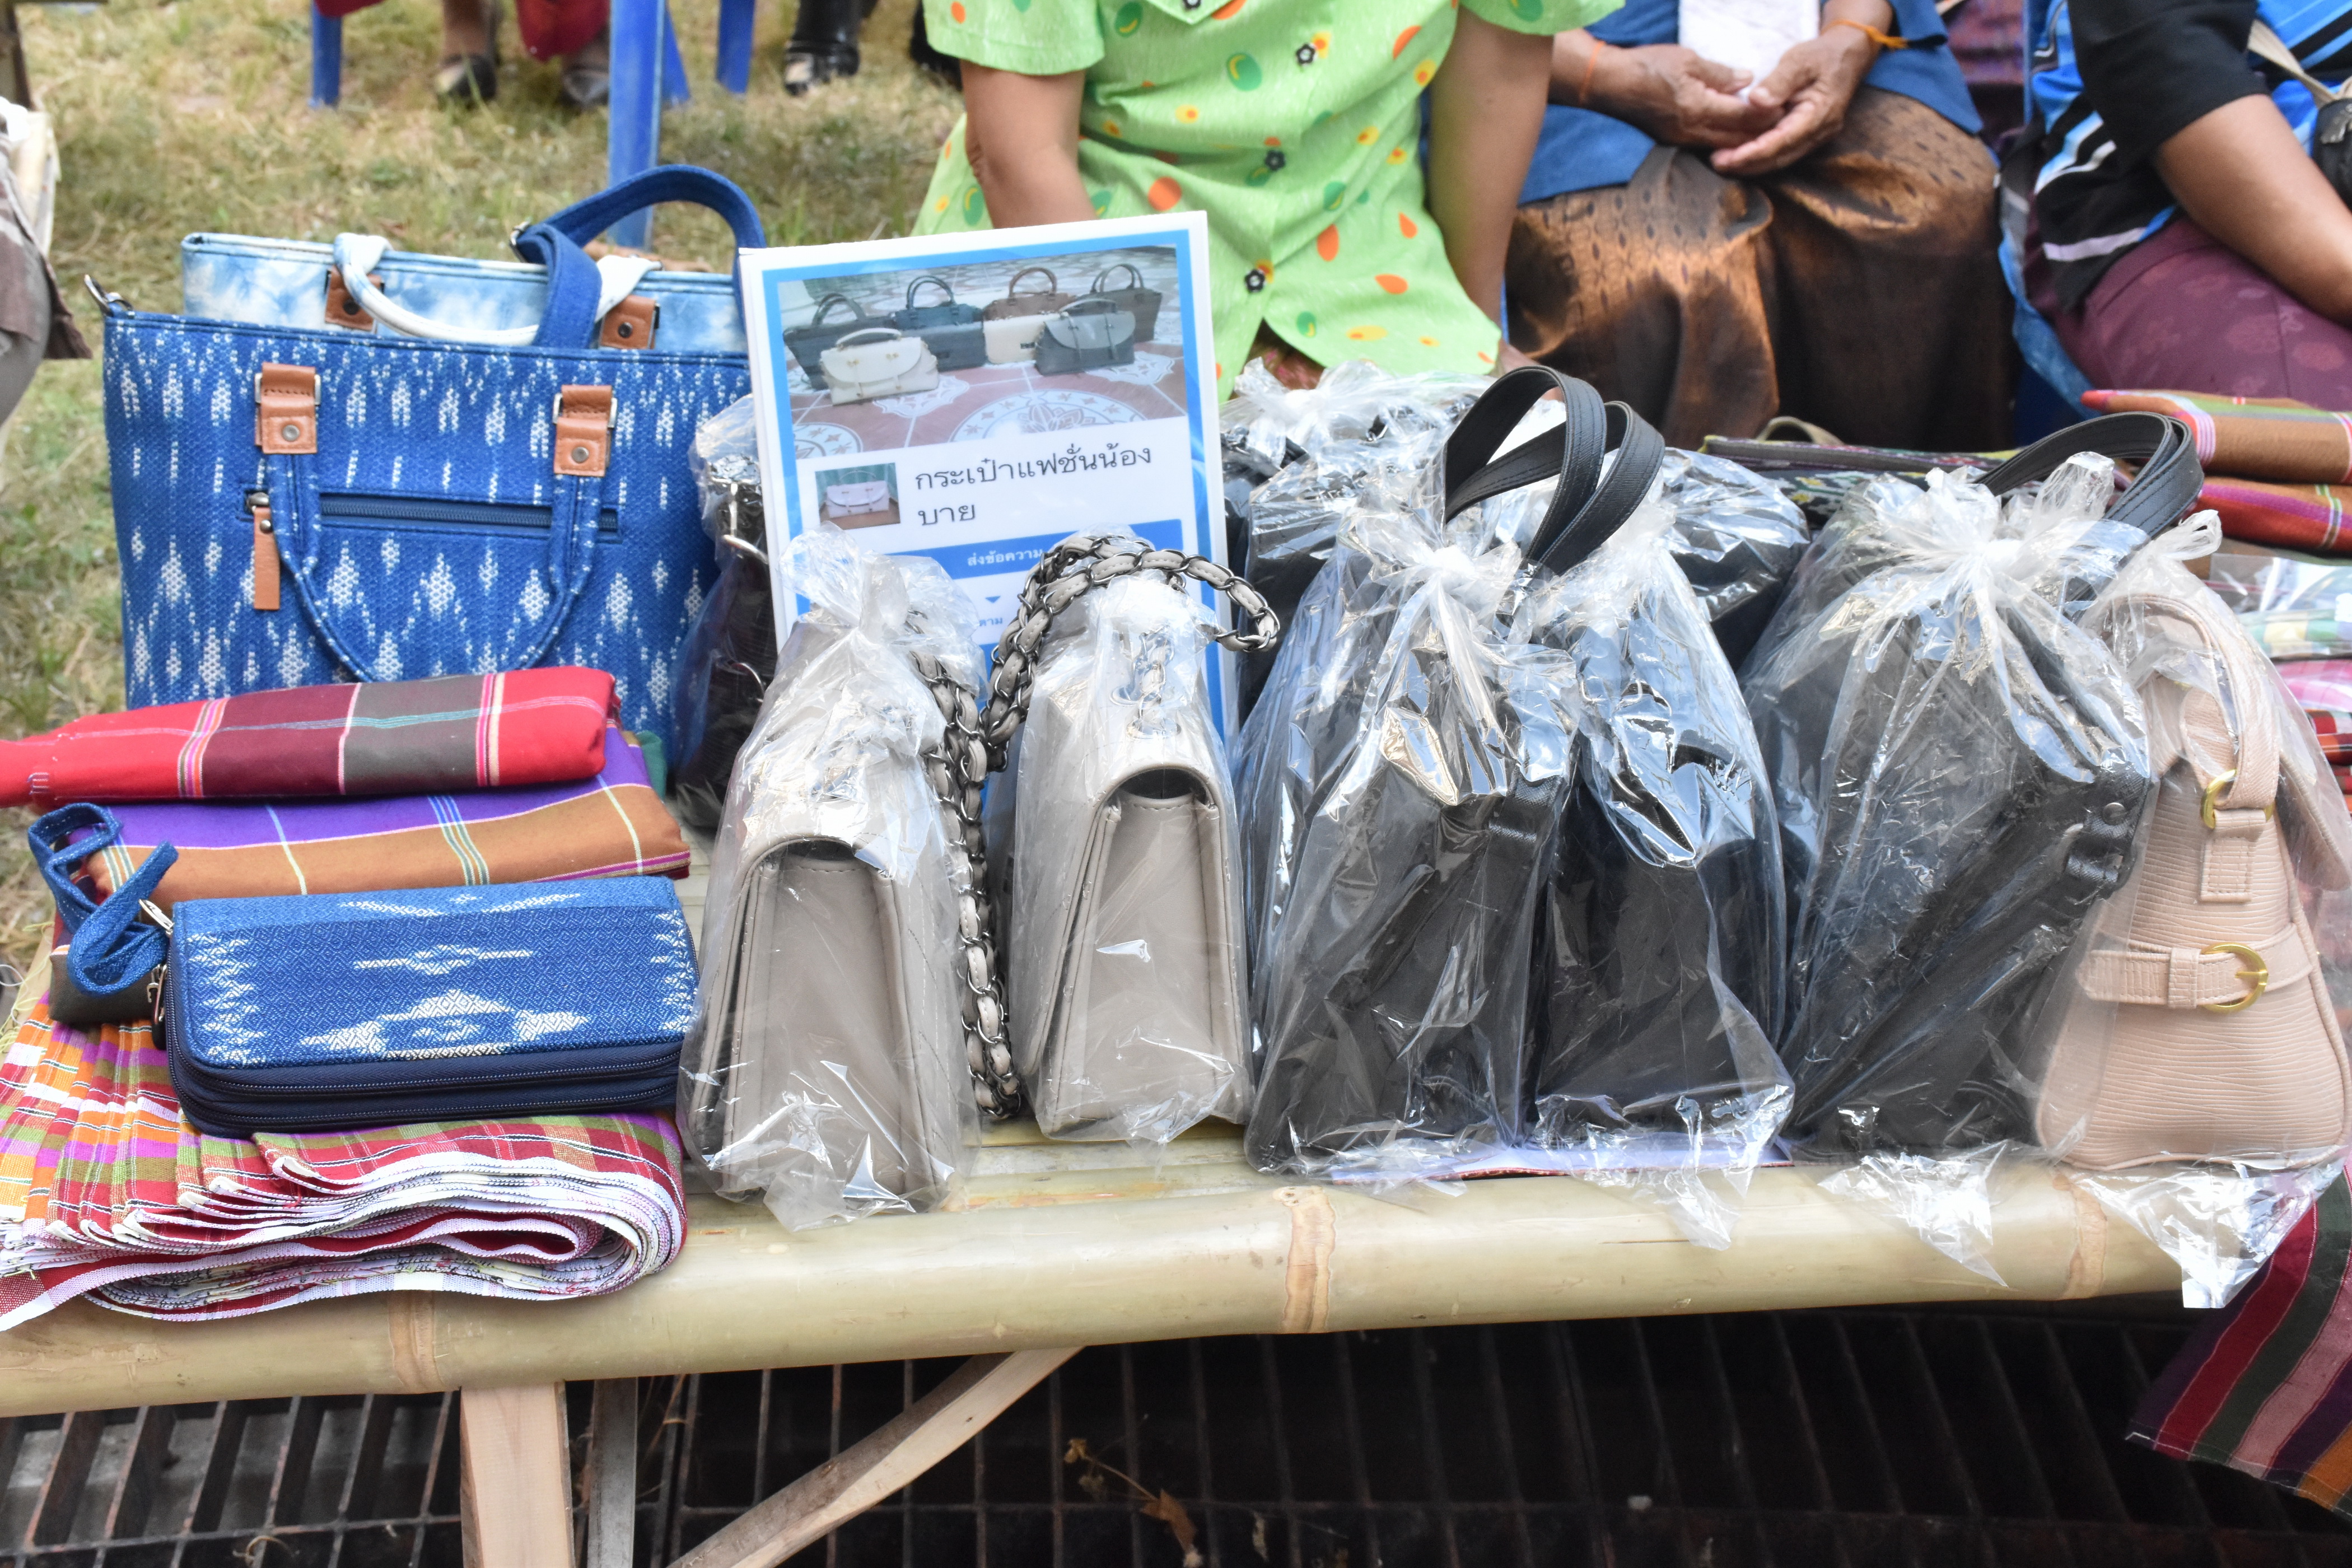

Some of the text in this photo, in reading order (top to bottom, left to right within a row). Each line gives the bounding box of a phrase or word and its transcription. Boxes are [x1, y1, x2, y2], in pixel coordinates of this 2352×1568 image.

[915, 443, 1151, 489] กระเป๋าแฟชั่นน้อง
[917, 505, 976, 525] บาย
